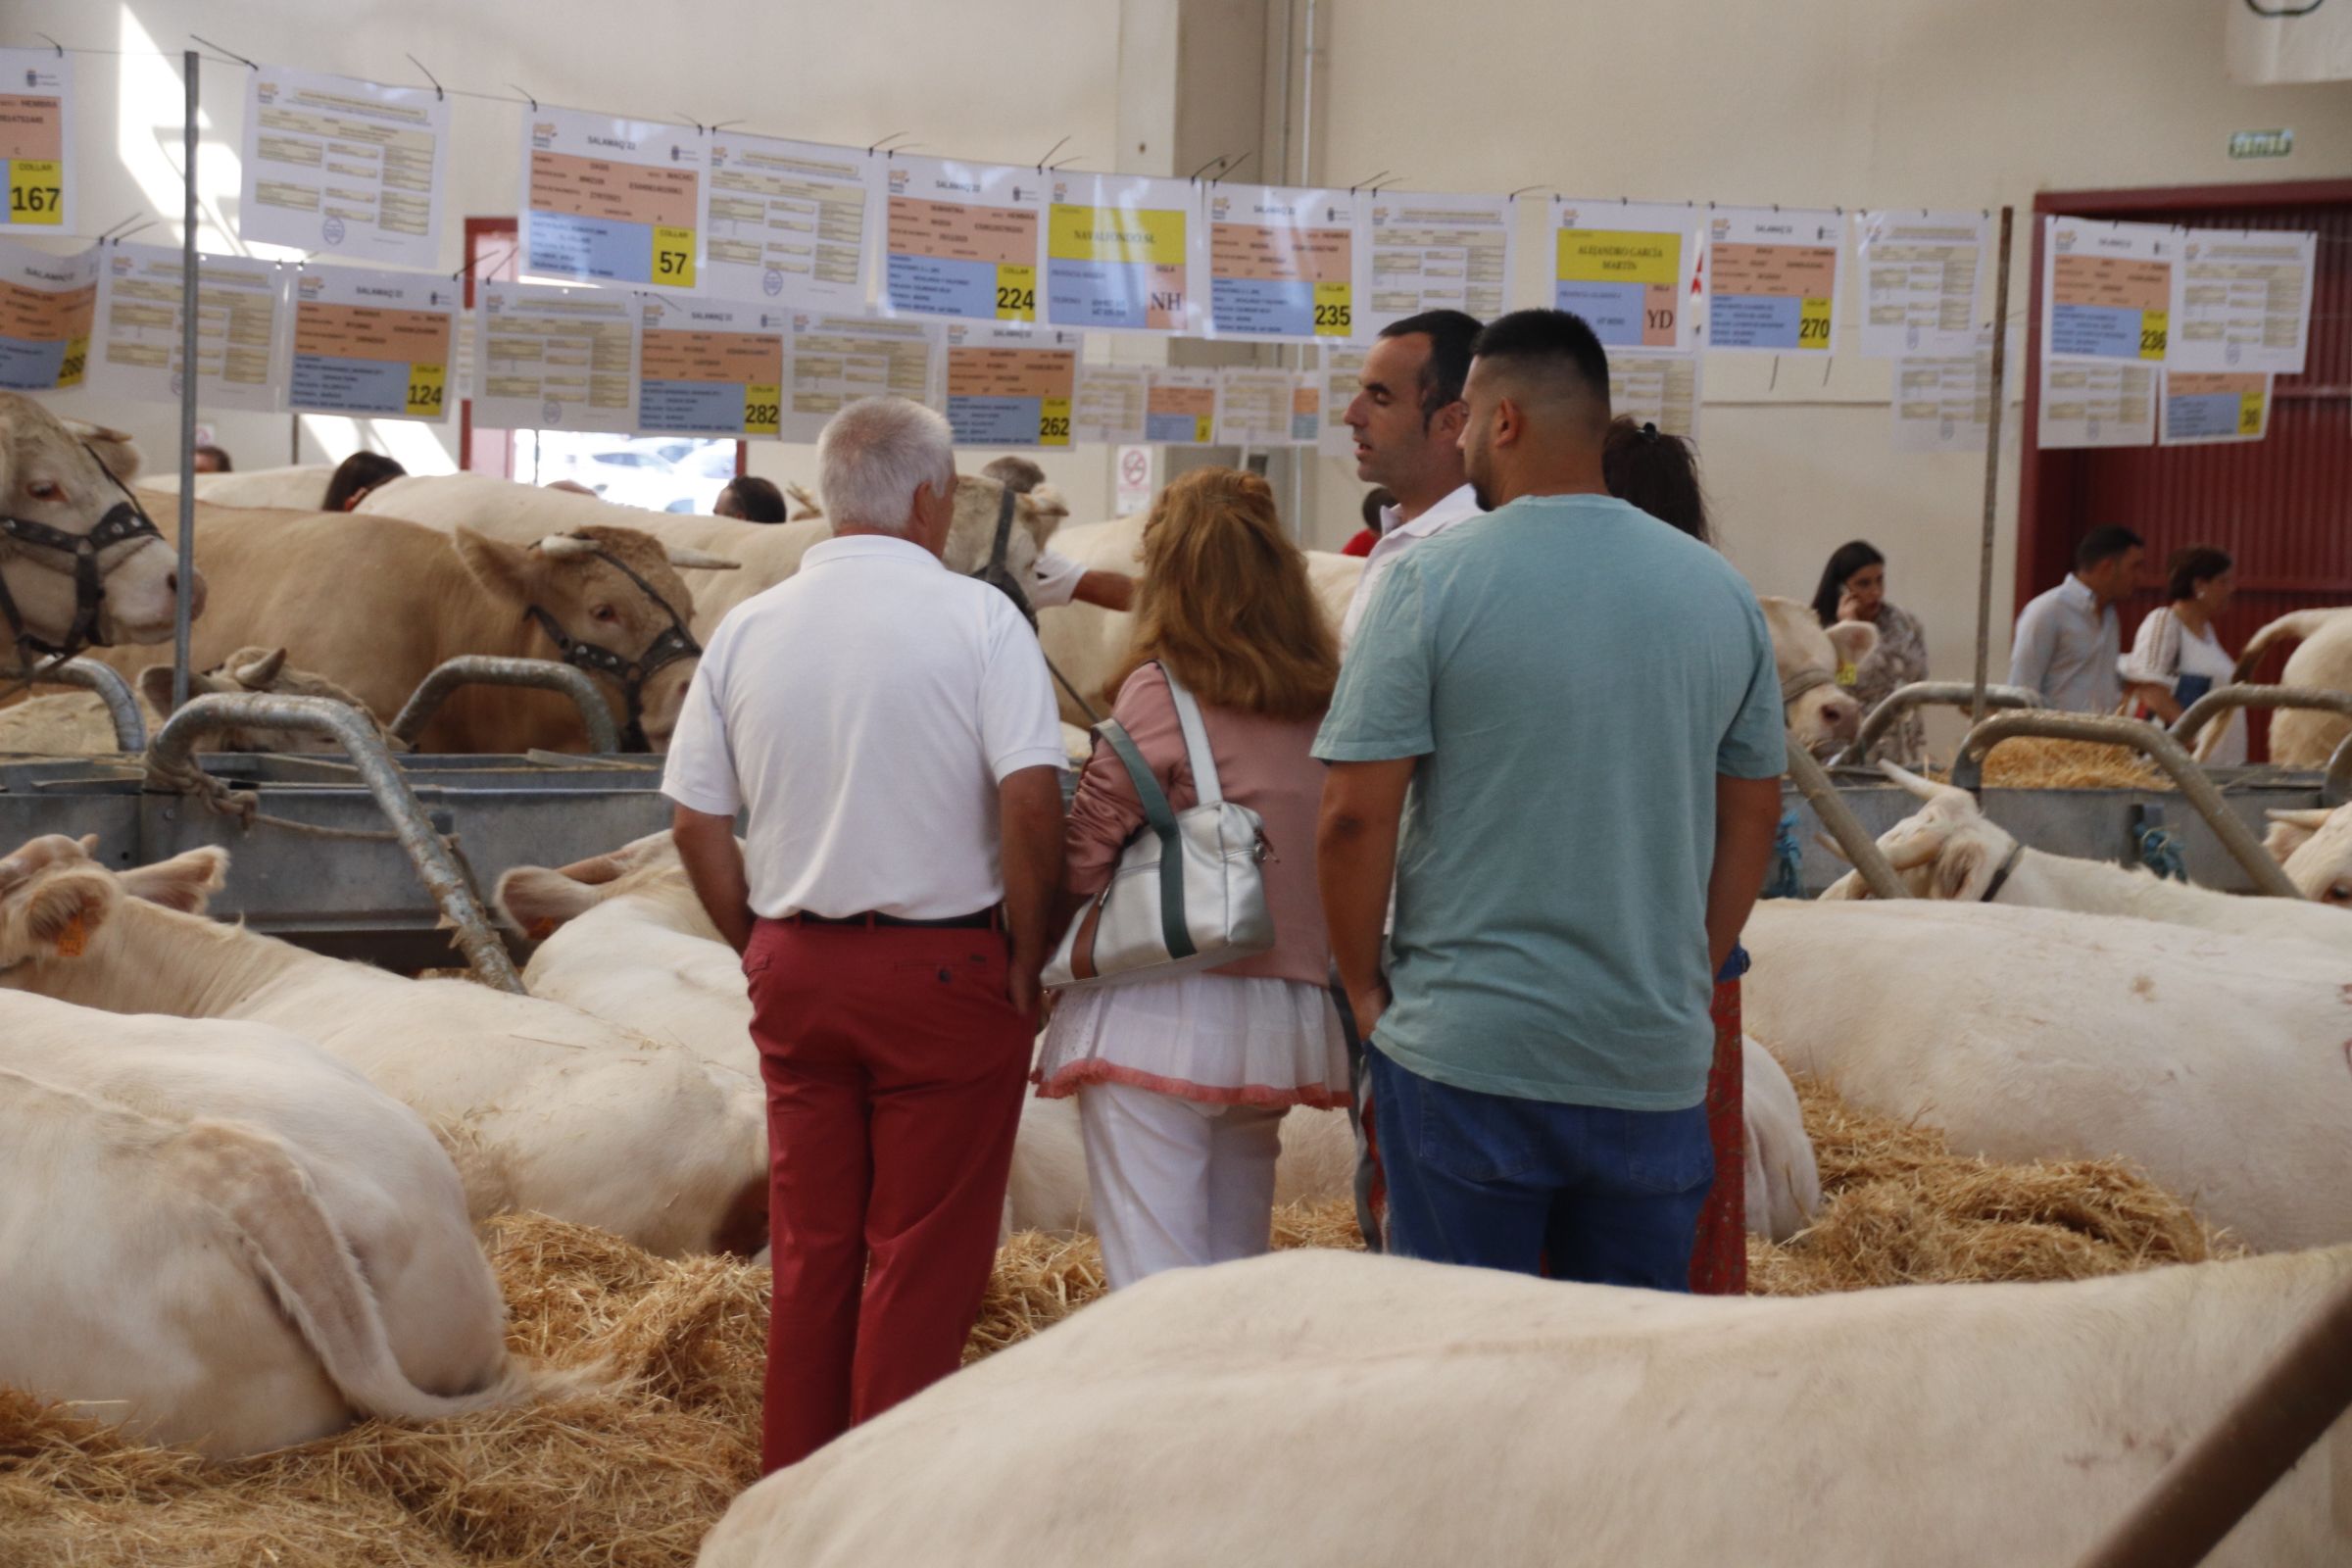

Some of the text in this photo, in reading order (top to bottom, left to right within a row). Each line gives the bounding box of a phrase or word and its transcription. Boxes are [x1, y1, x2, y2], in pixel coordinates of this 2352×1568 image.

[19, 163, 54, 172] COLLAR
[11, 186, 61, 213] 167
[660, 251, 688, 274] 57
[997, 287, 1035, 310] 224
[1152, 292, 1181, 311] NH
[1314, 305, 1351, 326] 235
[1647, 309, 1674, 329] YD
[1800, 318, 1831, 338] 270
[407, 384, 443, 406] 124
[745, 404, 779, 424] 282
[1040, 417, 1069, 437] 262
